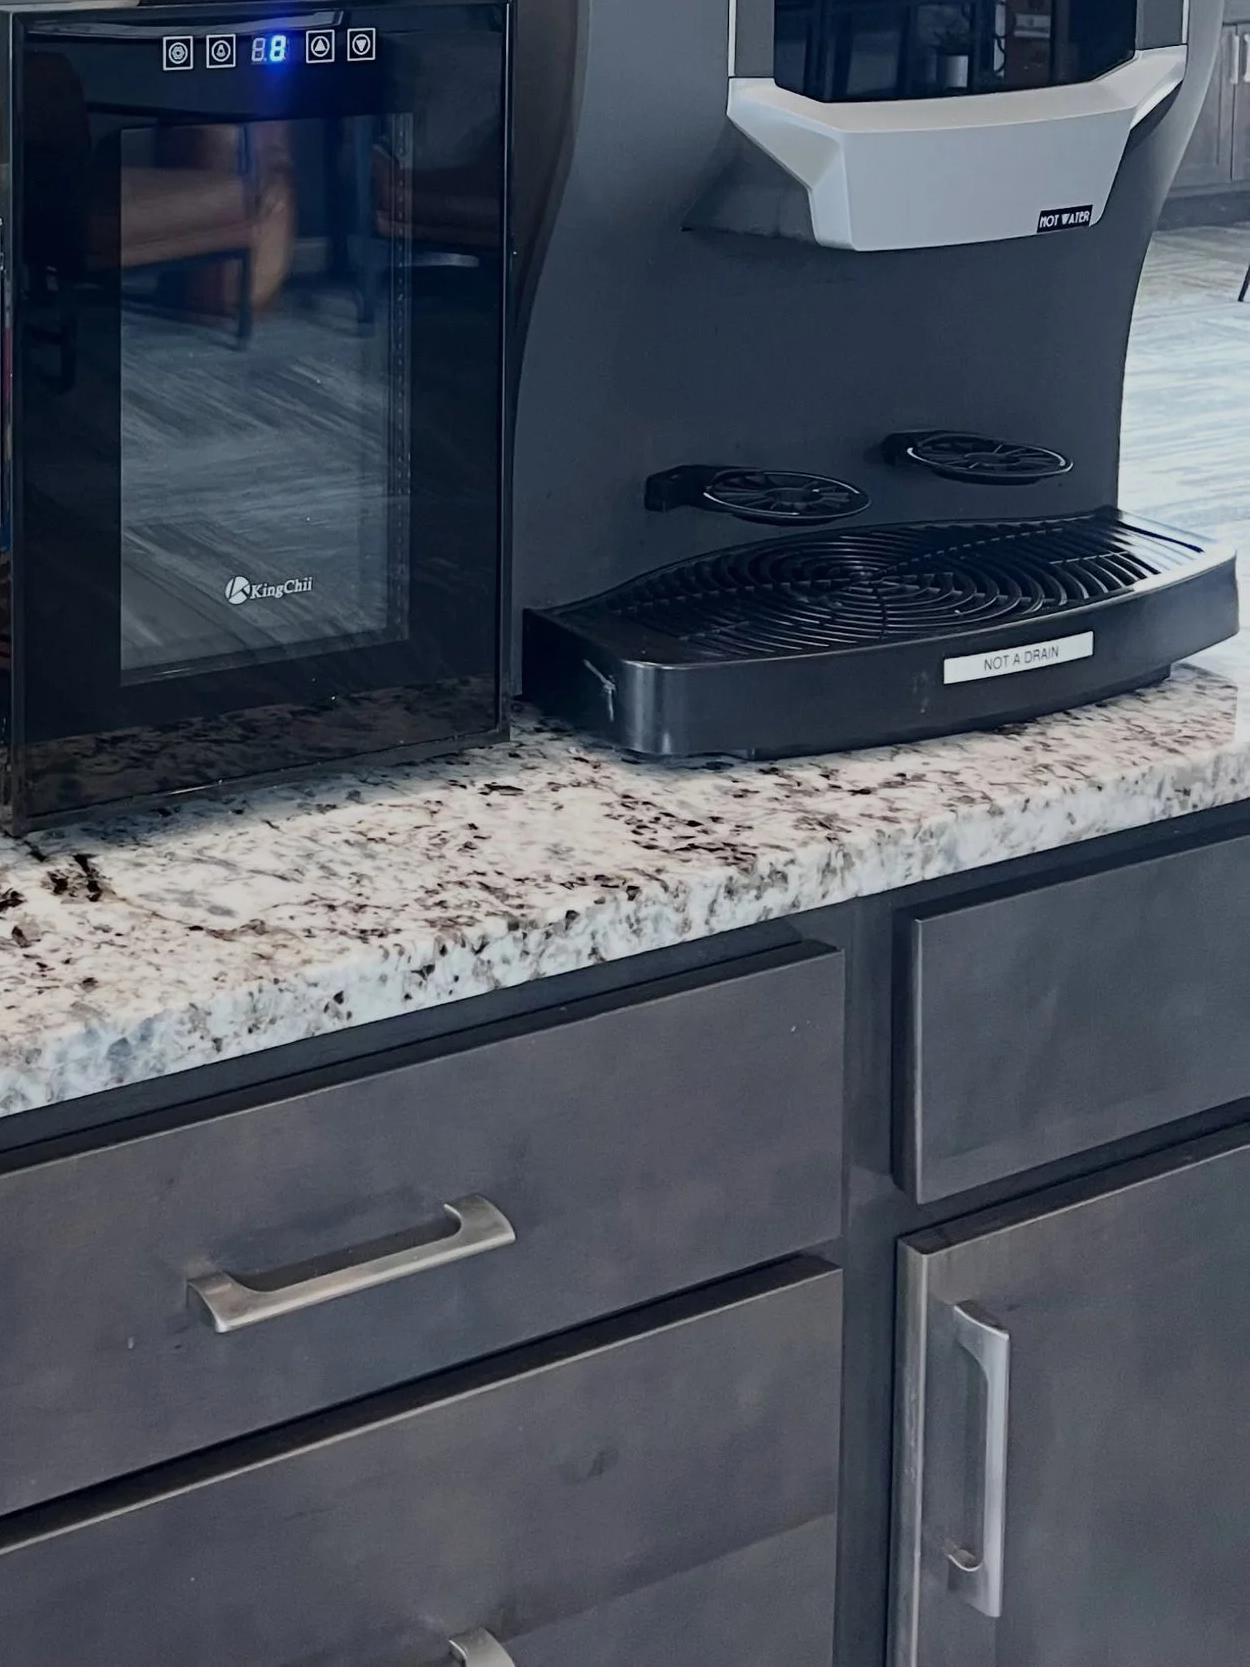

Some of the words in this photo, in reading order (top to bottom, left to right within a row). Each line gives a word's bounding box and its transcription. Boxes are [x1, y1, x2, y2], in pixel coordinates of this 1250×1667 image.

[1061, 210, 1091, 225] WATER
[250, 577, 313, 599] KingChii
[983, 654, 1010, 671] NOT
[1012, 653, 1021, 666] A
[1024, 645, 1060, 664] DRAIN
